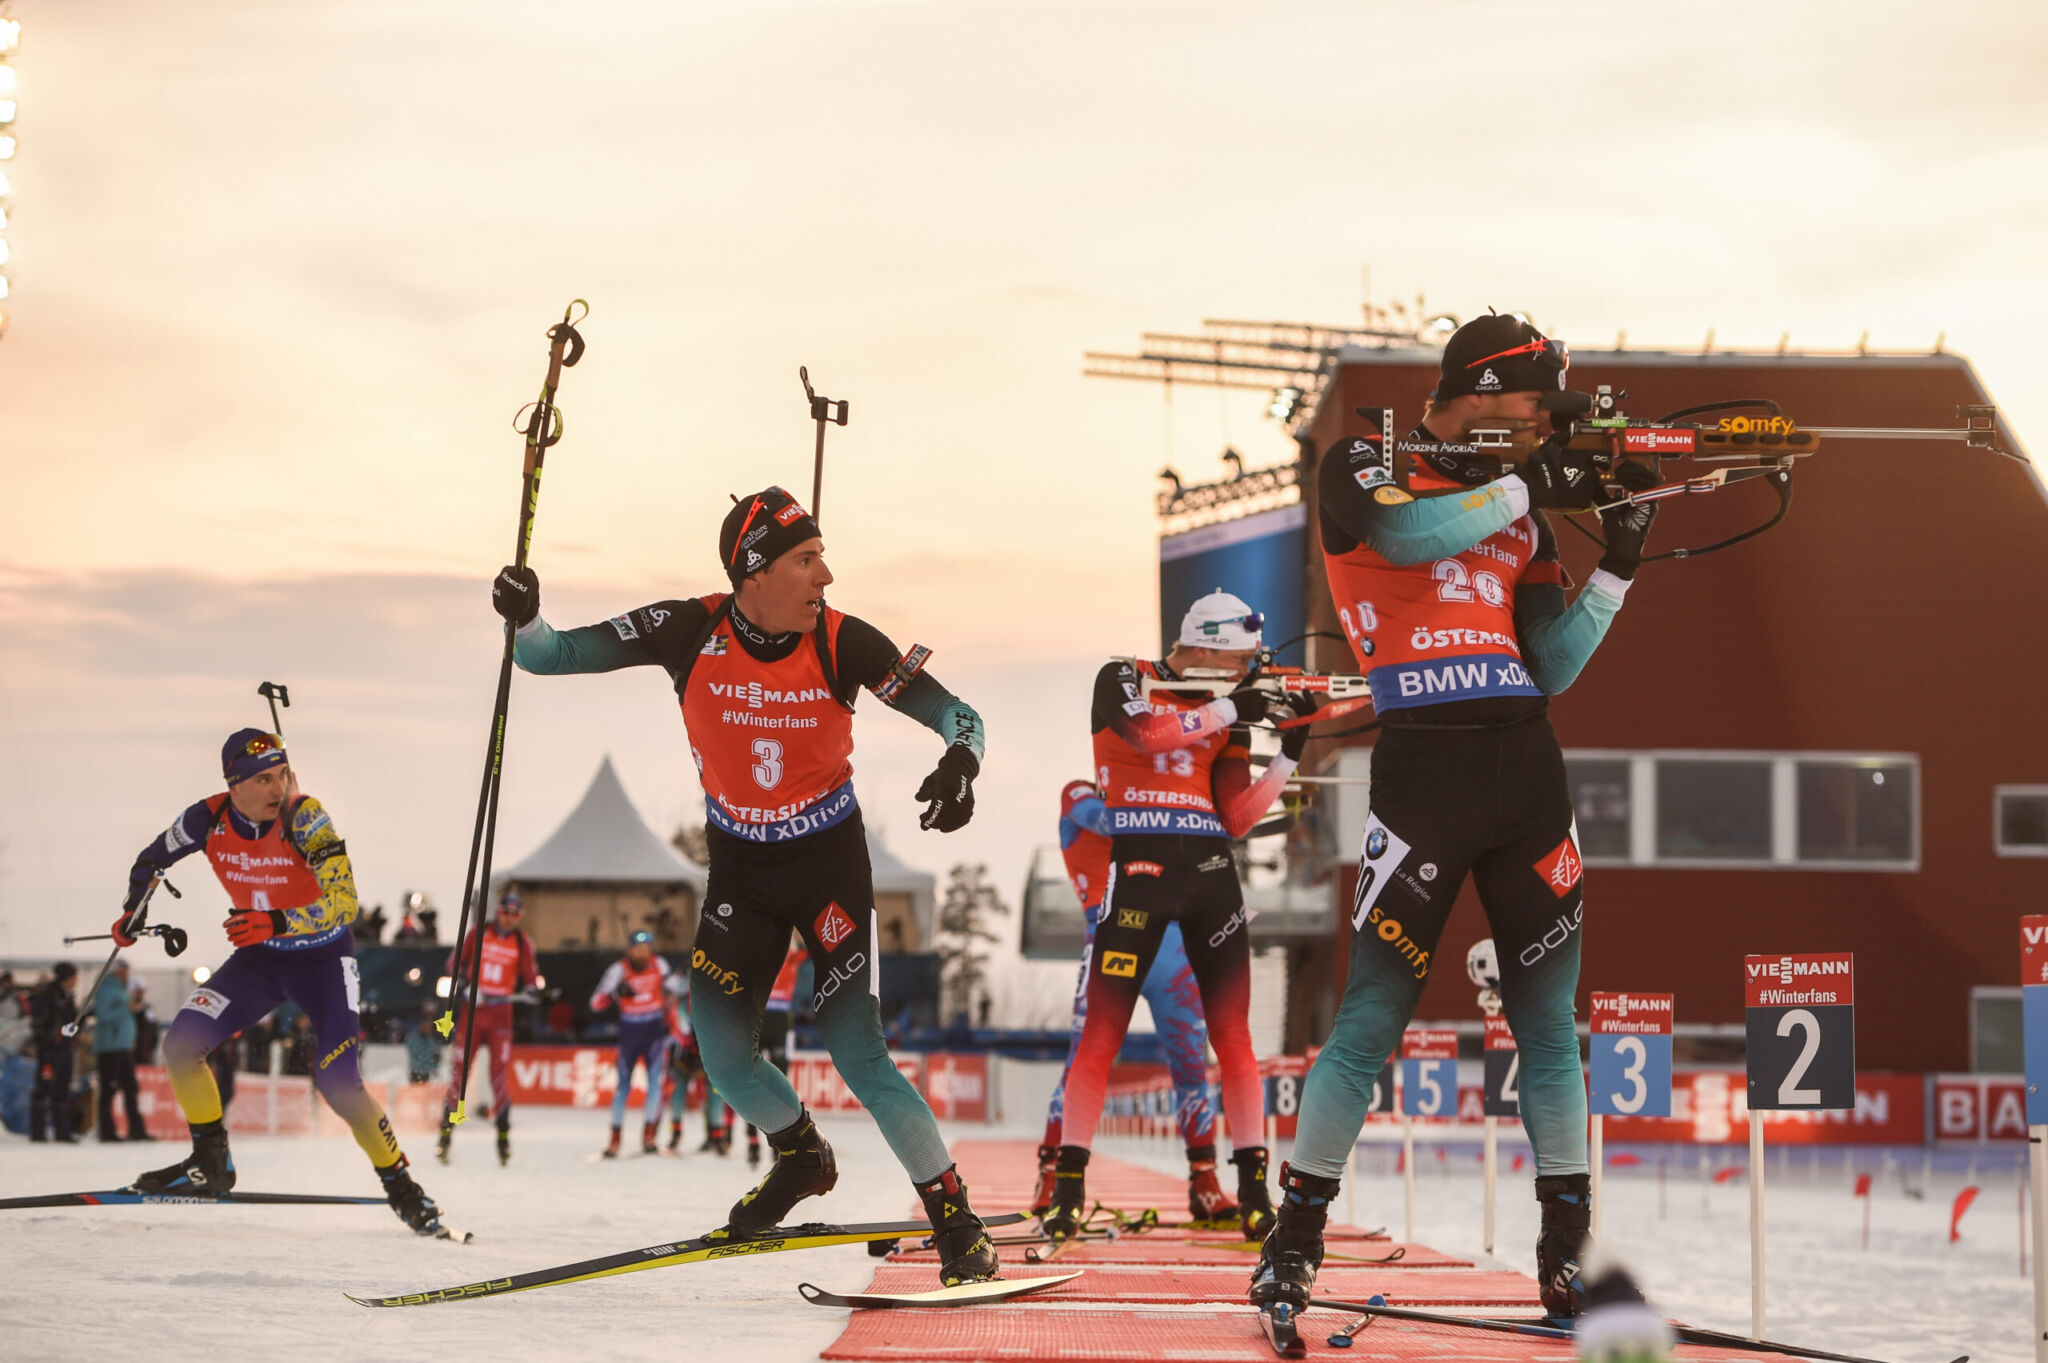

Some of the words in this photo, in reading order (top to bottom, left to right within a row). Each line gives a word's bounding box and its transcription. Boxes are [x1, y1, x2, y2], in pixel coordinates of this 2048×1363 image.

[1719, 416, 1793, 436] somfy
[1626, 432, 1692, 448] VIESSMANN
[1398, 662, 1487, 697] BMW
[708, 682, 832, 709] VIESSMANN
[722, 710, 819, 729] #Winterfans
[751, 737, 784, 791] 3
[1115, 811, 1170, 829] BMW
[217, 851, 295, 871] VIESSMANN
[226, 871, 289, 885] #Winterfans
[1368, 907, 1430, 980] somfy
[692, 947, 744, 996] omfy
[1747, 957, 1849, 985] VIESSMANN
[1592, 994, 1672, 1018] VIESSMANN
[1759, 988, 1838, 1005] #Winterfans
[1601, 1020, 1661, 1034] #Winterfans
[319, 1039, 353, 1070] CRAFT
[1776, 1008, 1821, 1105] 2
[1417, 1060, 1442, 1115] 5
[1610, 1036, 1648, 1115] 3
[1276, 1075, 1297, 1116] 8
[706, 1239, 786, 1259] FISCHER
